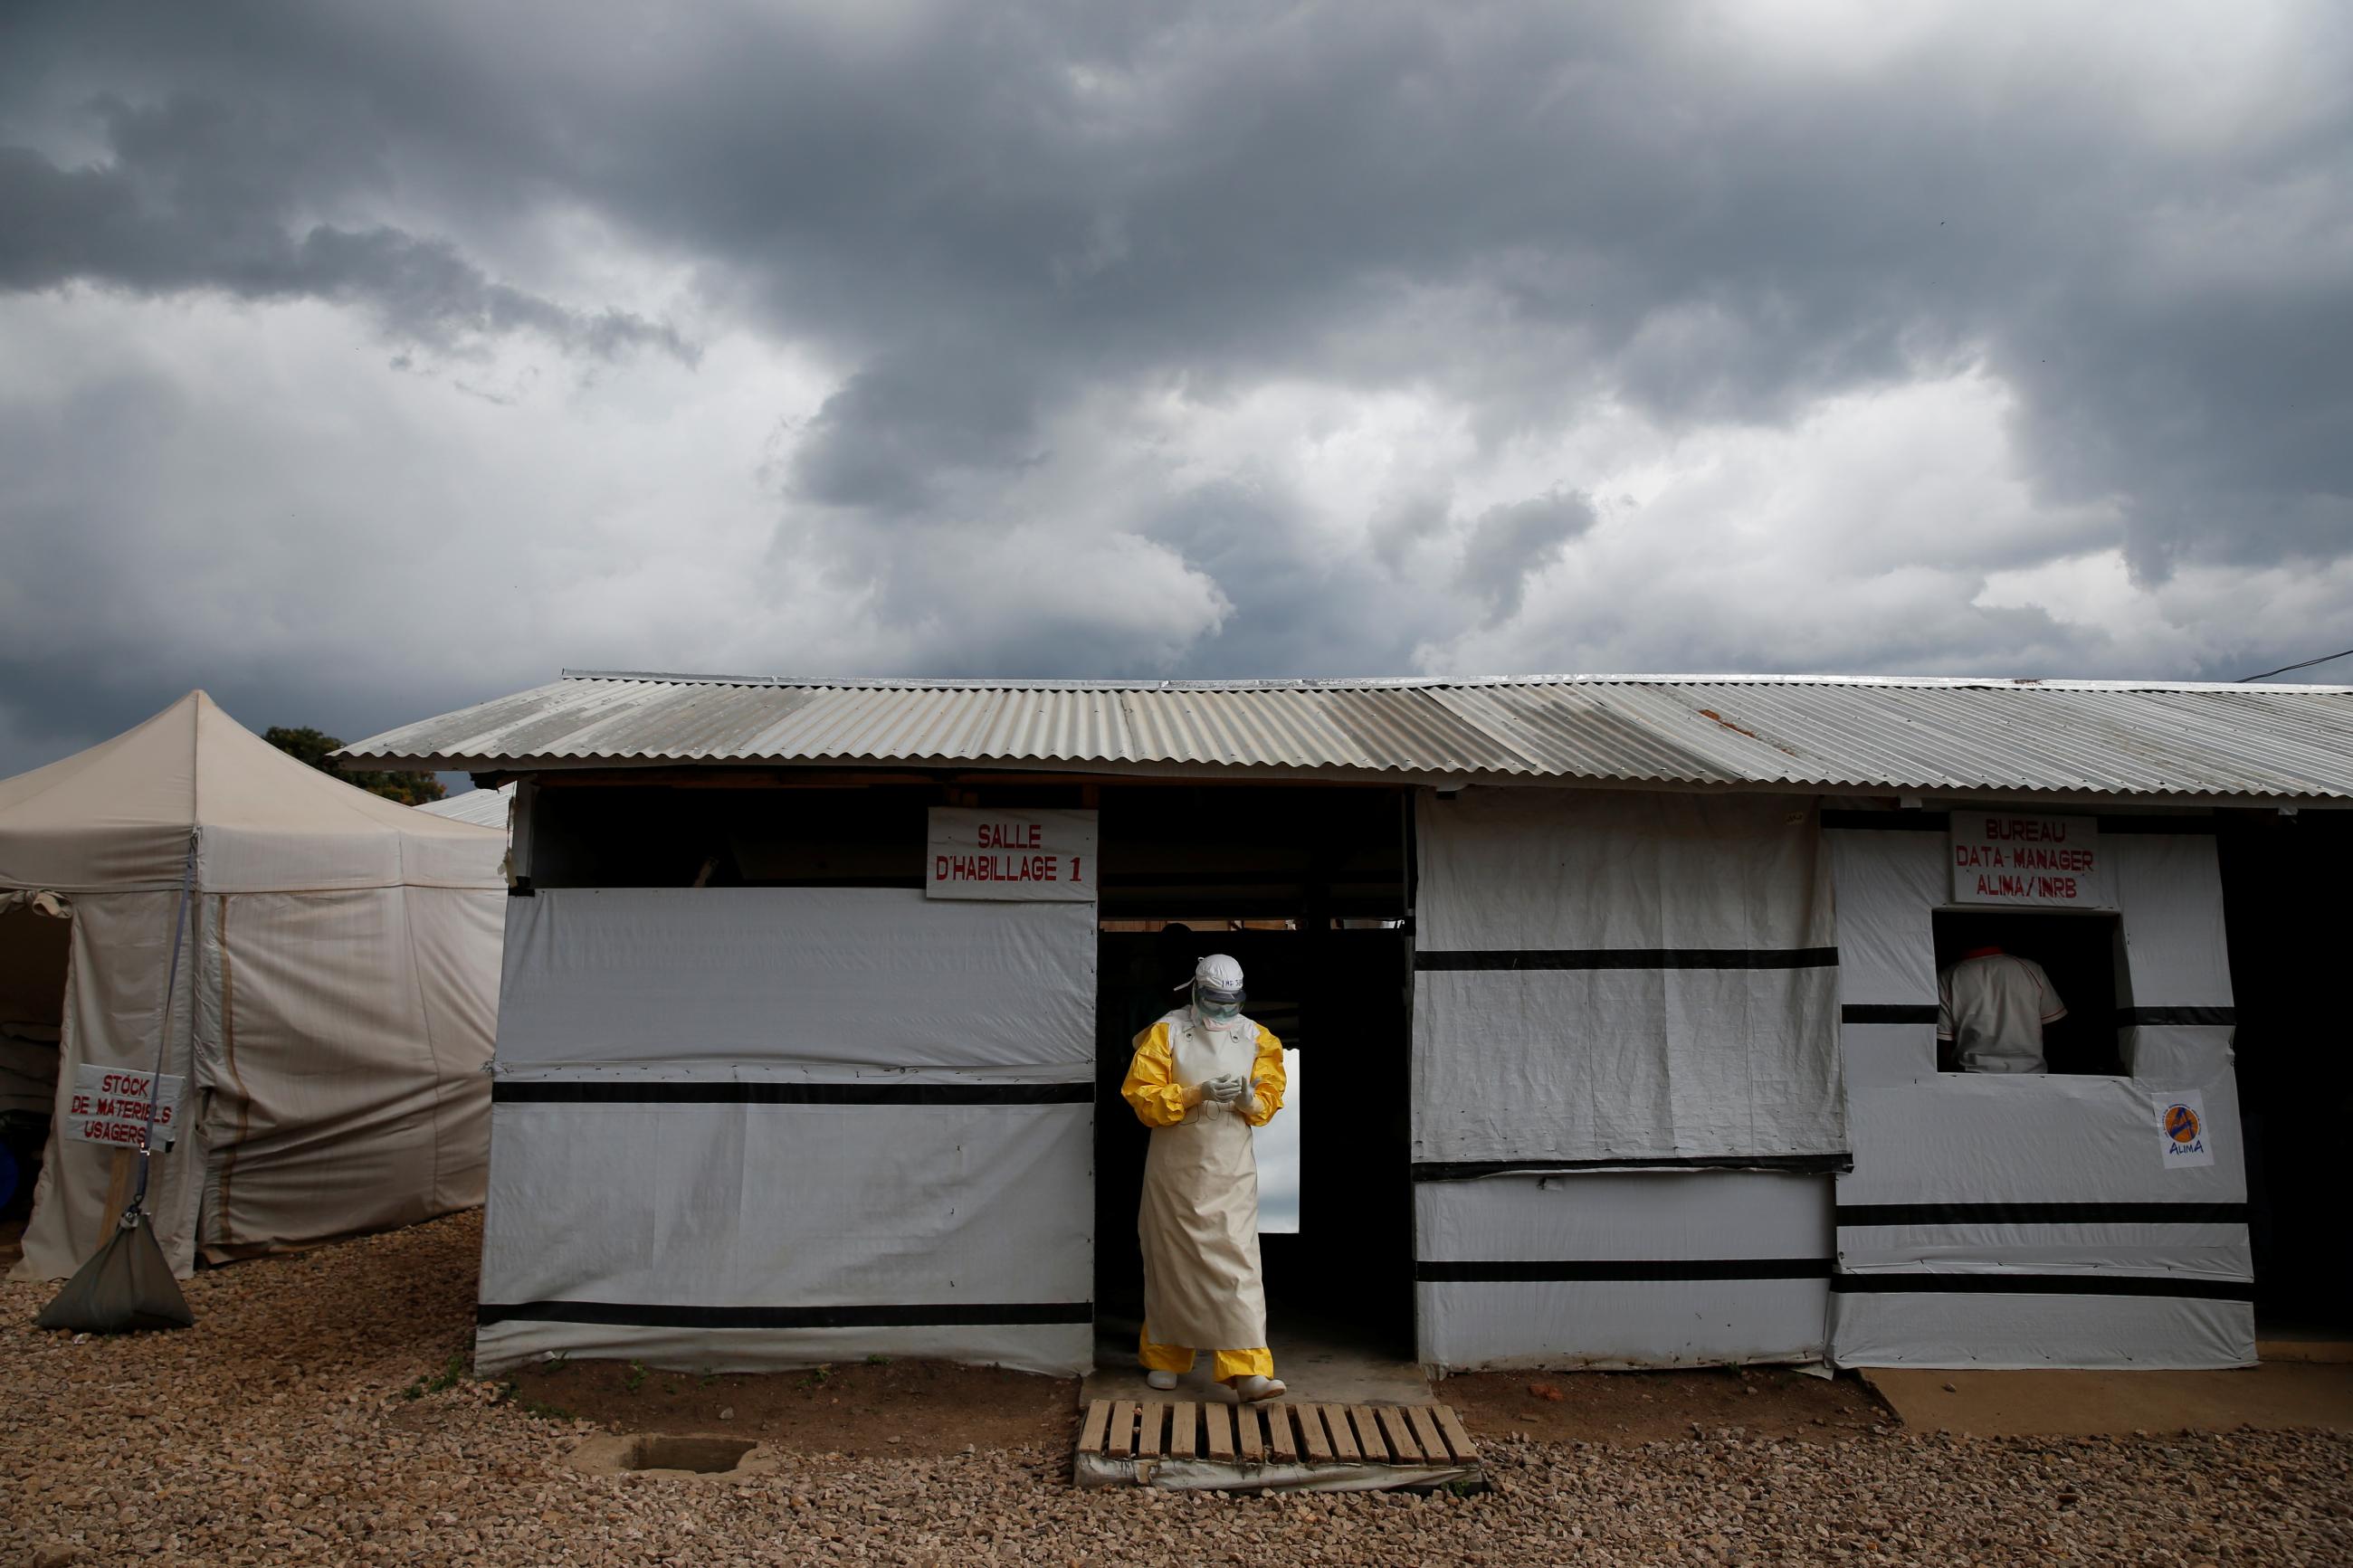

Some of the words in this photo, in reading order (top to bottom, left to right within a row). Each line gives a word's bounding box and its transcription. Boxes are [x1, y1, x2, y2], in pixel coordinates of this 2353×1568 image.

[977, 823, 1042, 850] SALLE
[1986, 818, 2066, 842] BUREAU
[936, 855, 1057, 881] D'HABILLAGE
[1070, 857, 1082, 882] 1
[1955, 844, 2094, 872] DATA-MANAGER
[1976, 873, 2078, 898] ALIMA/INRB
[101, 1074, 150, 1098] STOCK
[71, 1095, 90, 1115] DE
[83, 1120, 148, 1145] USAGERS
[2169, 1139, 2205, 1155] ALIMA
